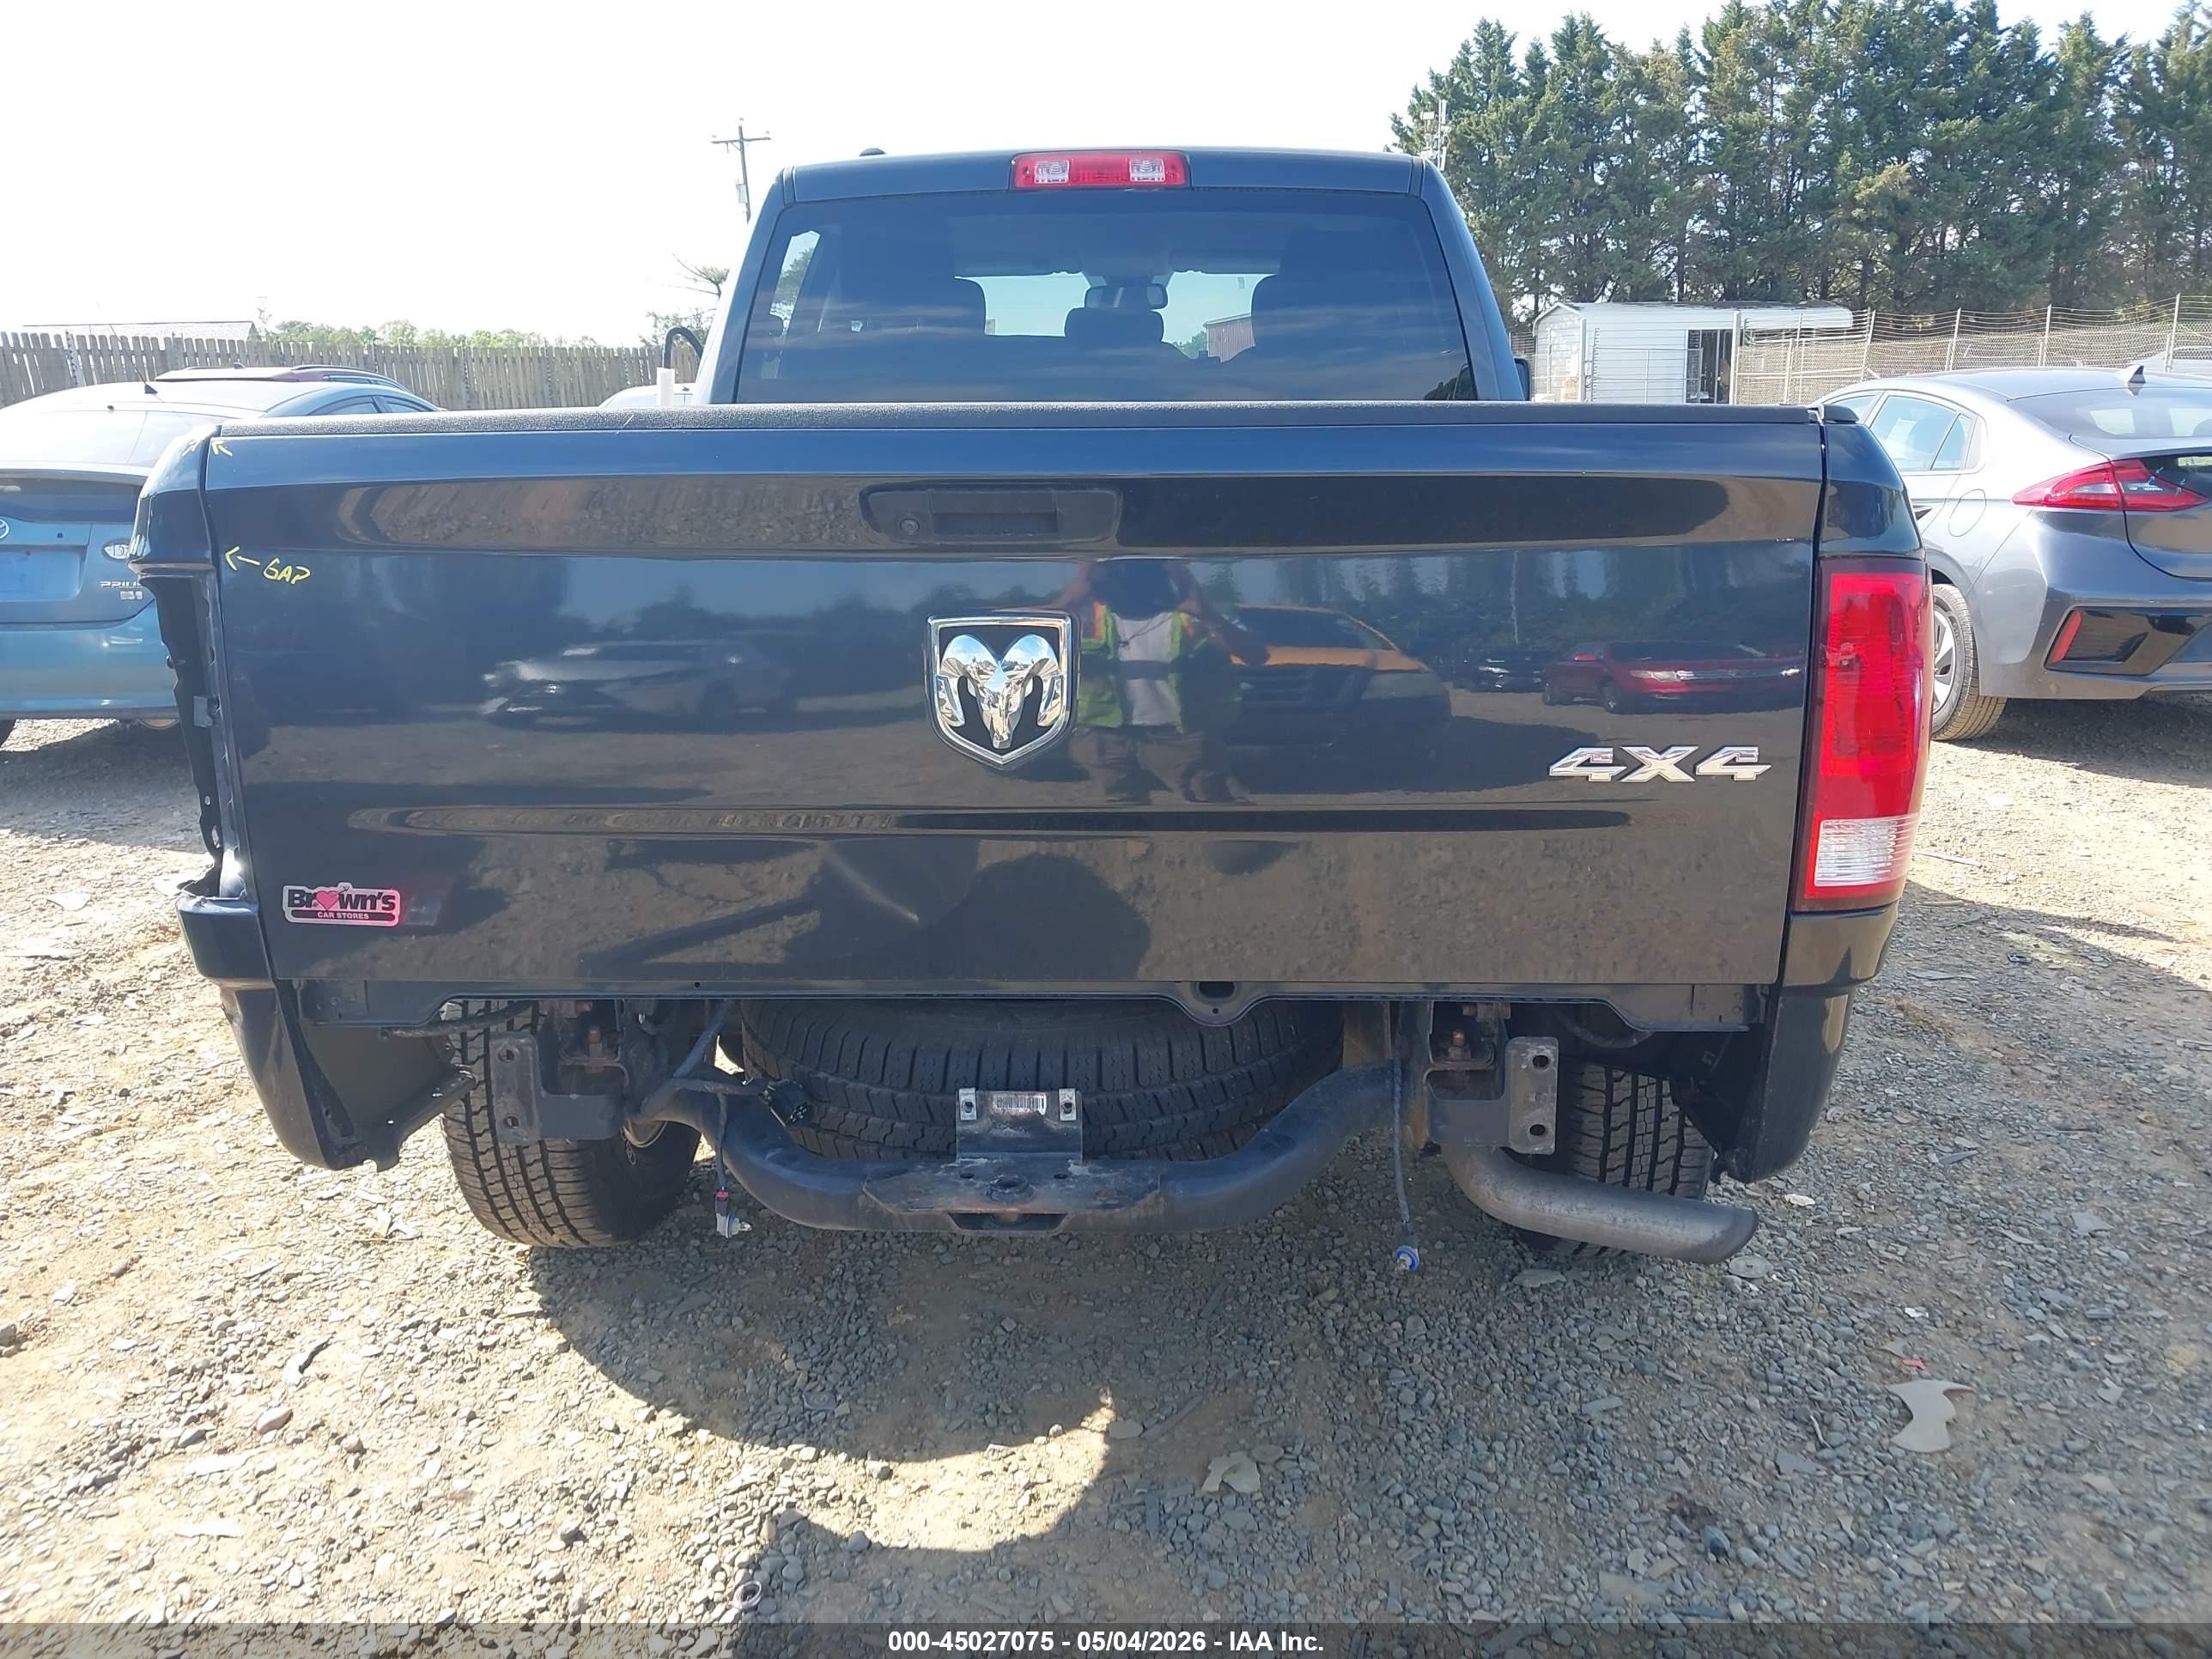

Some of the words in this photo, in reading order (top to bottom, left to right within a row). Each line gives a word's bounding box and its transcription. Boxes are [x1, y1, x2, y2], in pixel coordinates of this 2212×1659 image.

[263, 557, 311, 585] GAP
[1549, 745, 1771, 782] 4X4
[317, 911, 336, 920] CAR
[337, 912, 369, 921] STORES
